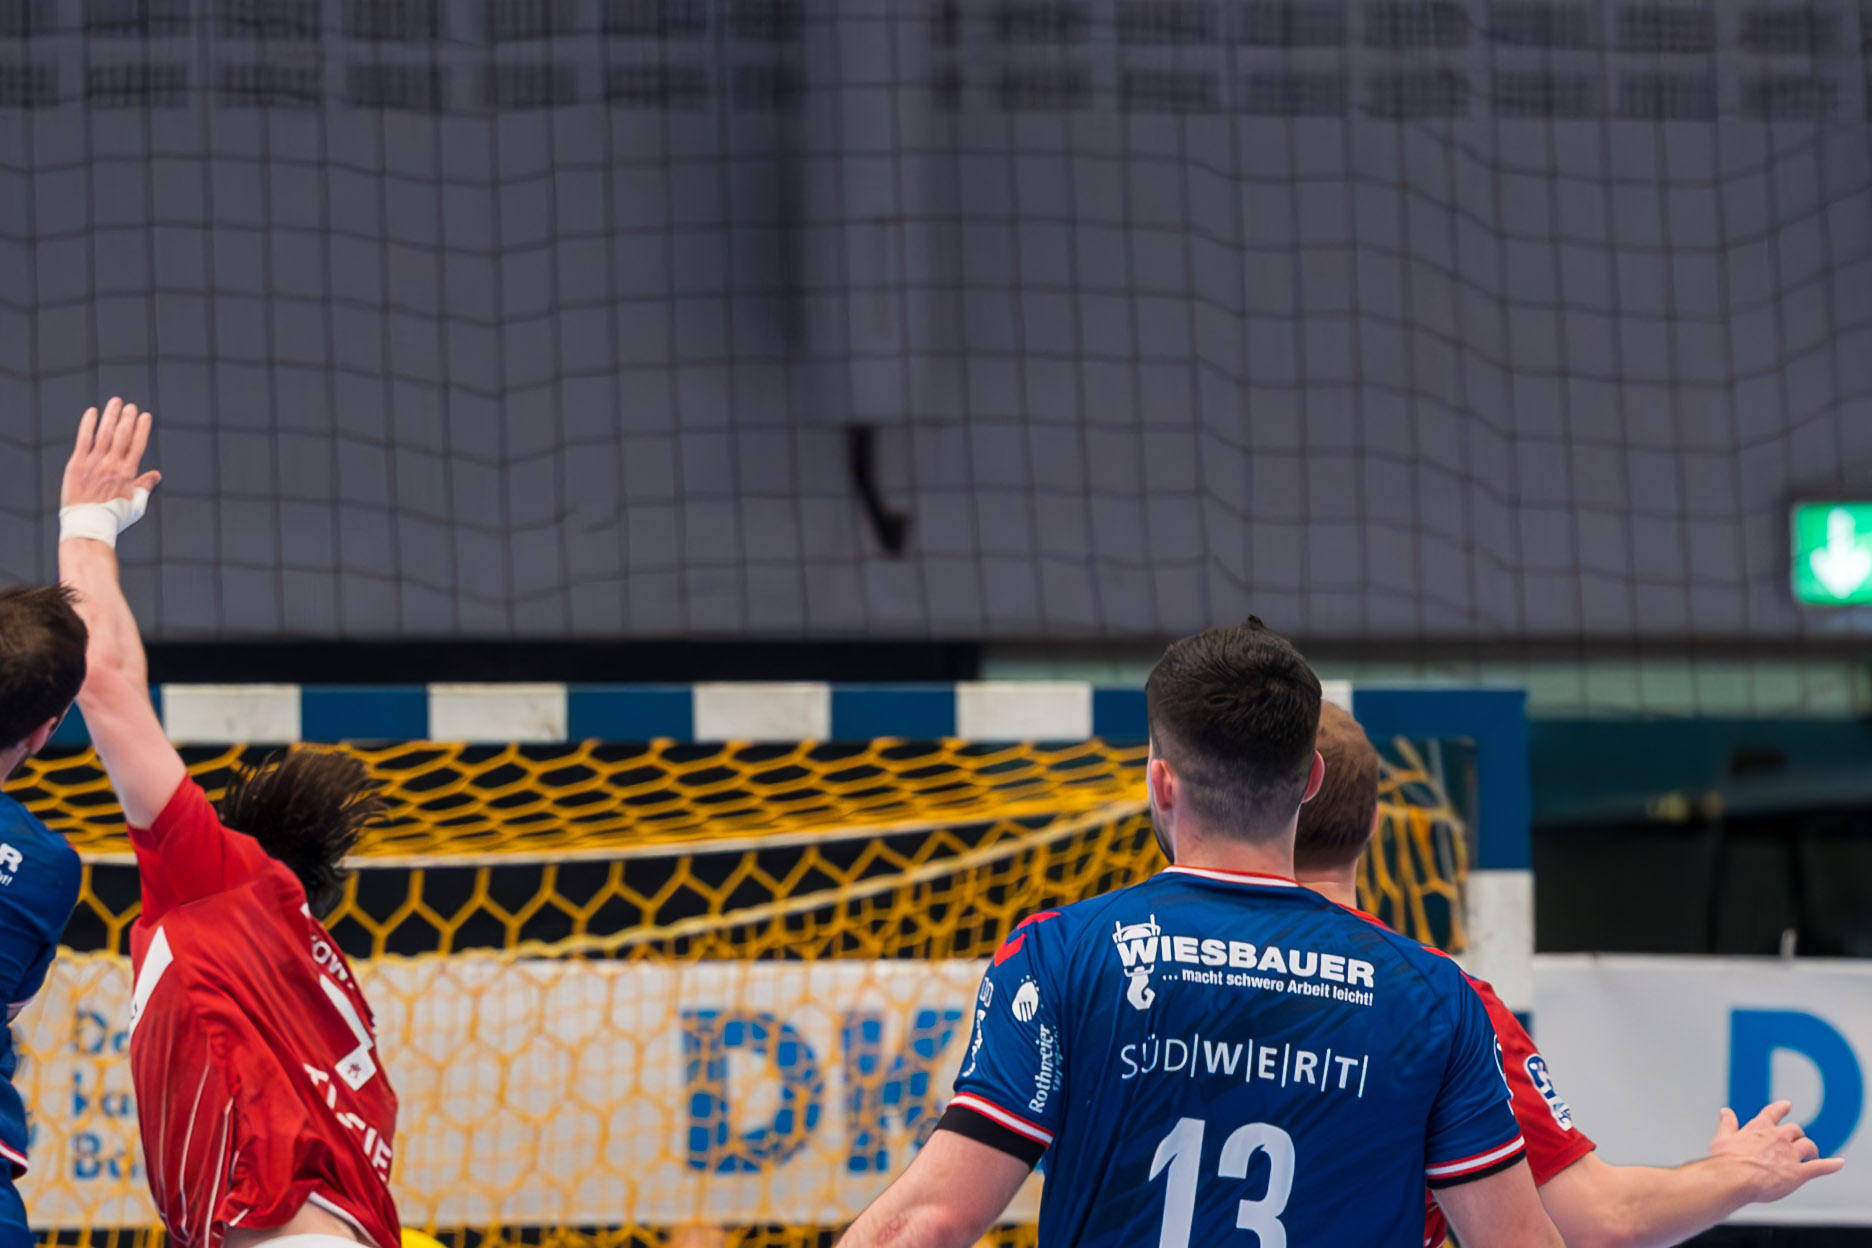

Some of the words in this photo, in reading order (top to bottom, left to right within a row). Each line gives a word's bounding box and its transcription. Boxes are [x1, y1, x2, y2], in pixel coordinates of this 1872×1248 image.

[1116, 935, 1375, 988] WIESBAUER
[1182, 968, 1224, 986] macht
[1226, 975, 1284, 992] schwere
[1287, 979, 1331, 998] Arbeit
[1332, 986, 1374, 1007] leicht!
[1029, 1023, 1054, 1113] Rothmeier
